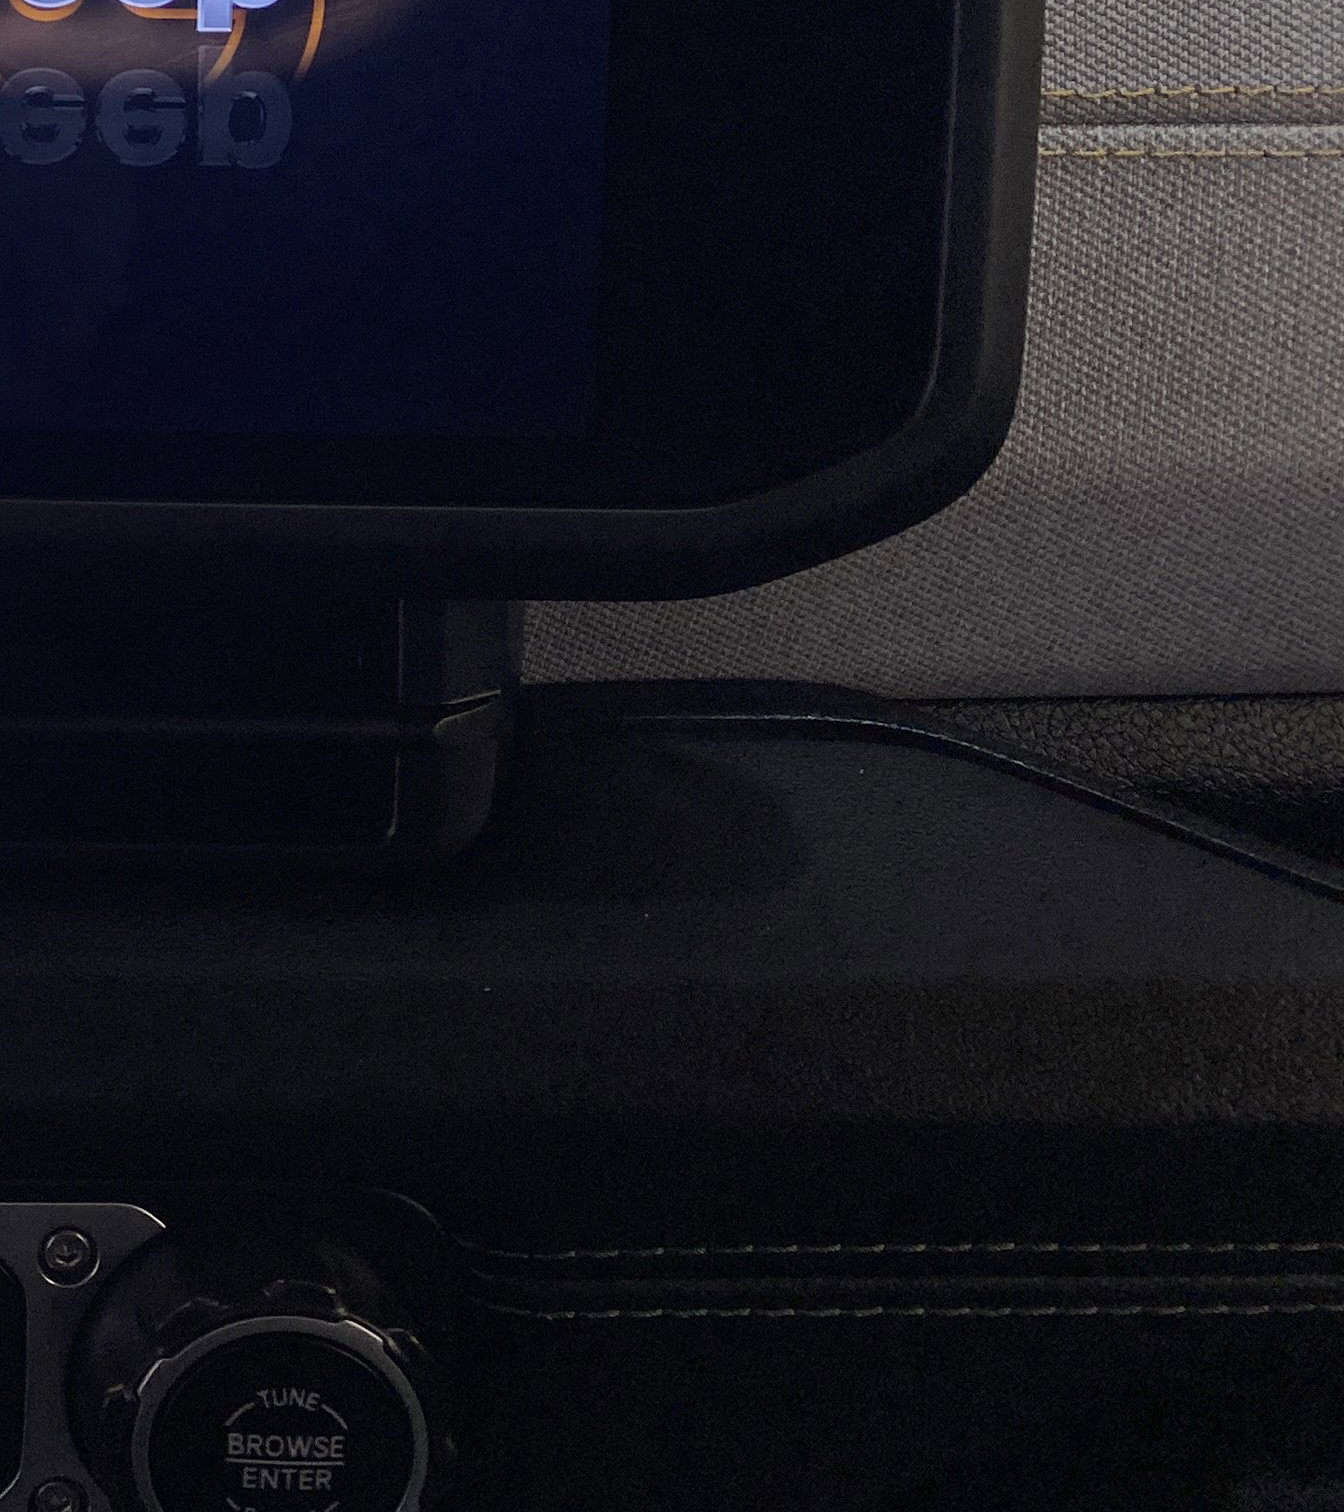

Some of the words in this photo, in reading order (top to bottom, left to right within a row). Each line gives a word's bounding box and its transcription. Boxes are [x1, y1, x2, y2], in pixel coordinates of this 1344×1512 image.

[257, 1388, 321, 1412] TUNE
[227, 1432, 346, 1458] BROWSE
[242, 1467, 333, 1491] ENTER
